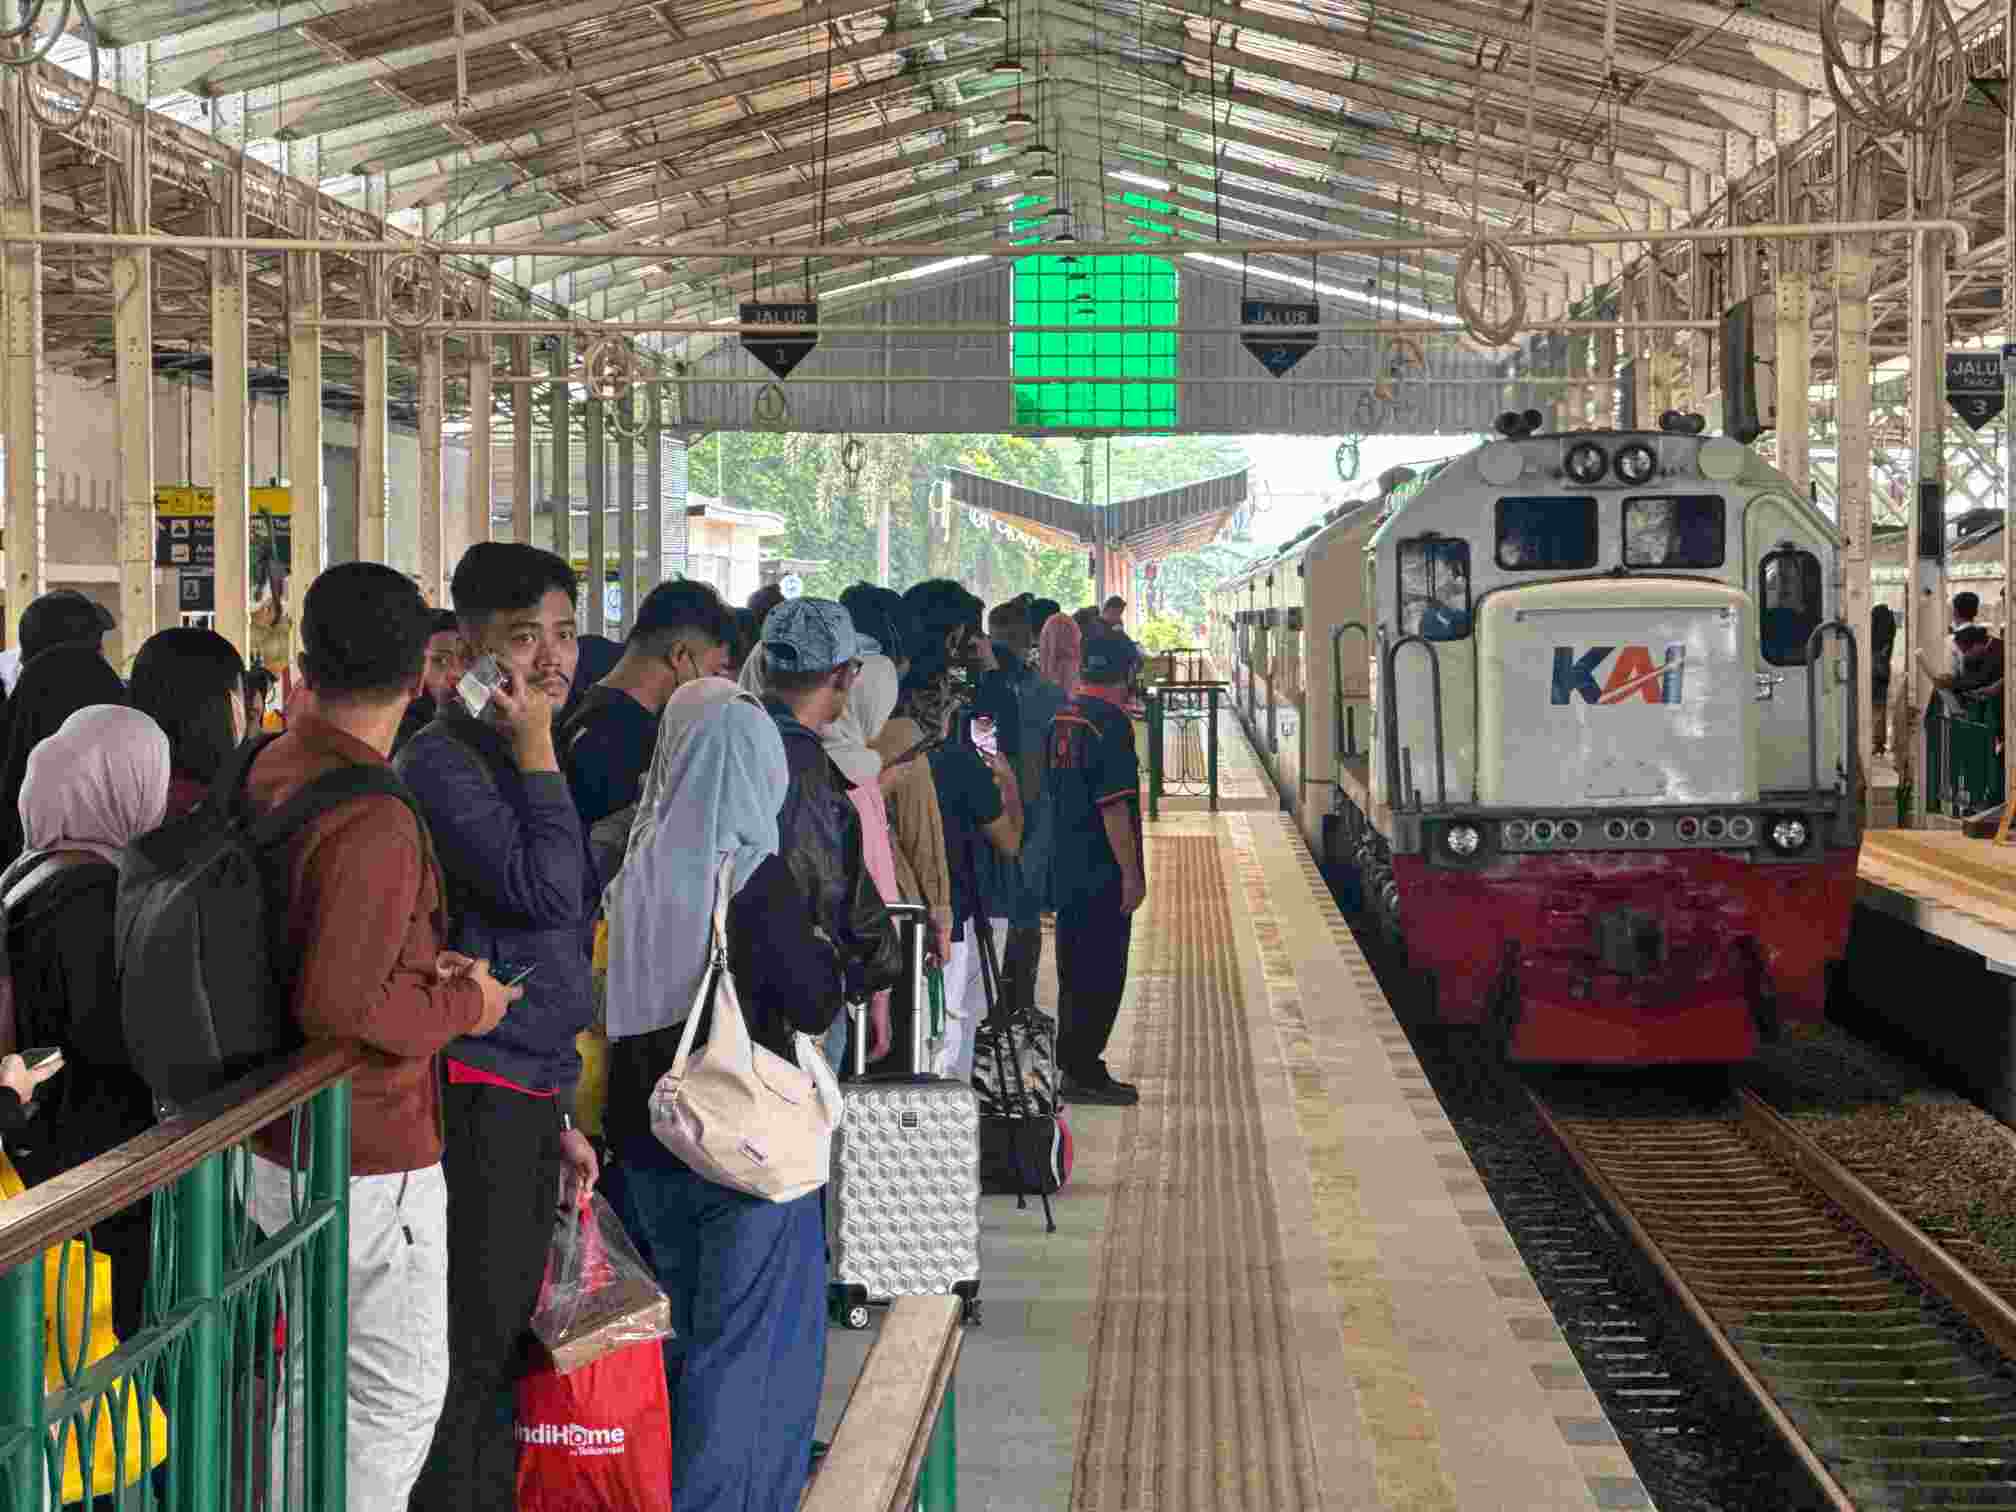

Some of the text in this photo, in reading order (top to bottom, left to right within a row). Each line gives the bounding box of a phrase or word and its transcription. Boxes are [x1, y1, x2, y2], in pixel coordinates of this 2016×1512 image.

[752, 309, 808, 325] JALUR
[1252, 309, 1308, 325] JALUR
[1272, 347, 1289, 365] 2
[1952, 360, 1999, 376] JALU
[1968, 400, 1988, 416] 3
[1551, 646, 1686, 704] KAI
